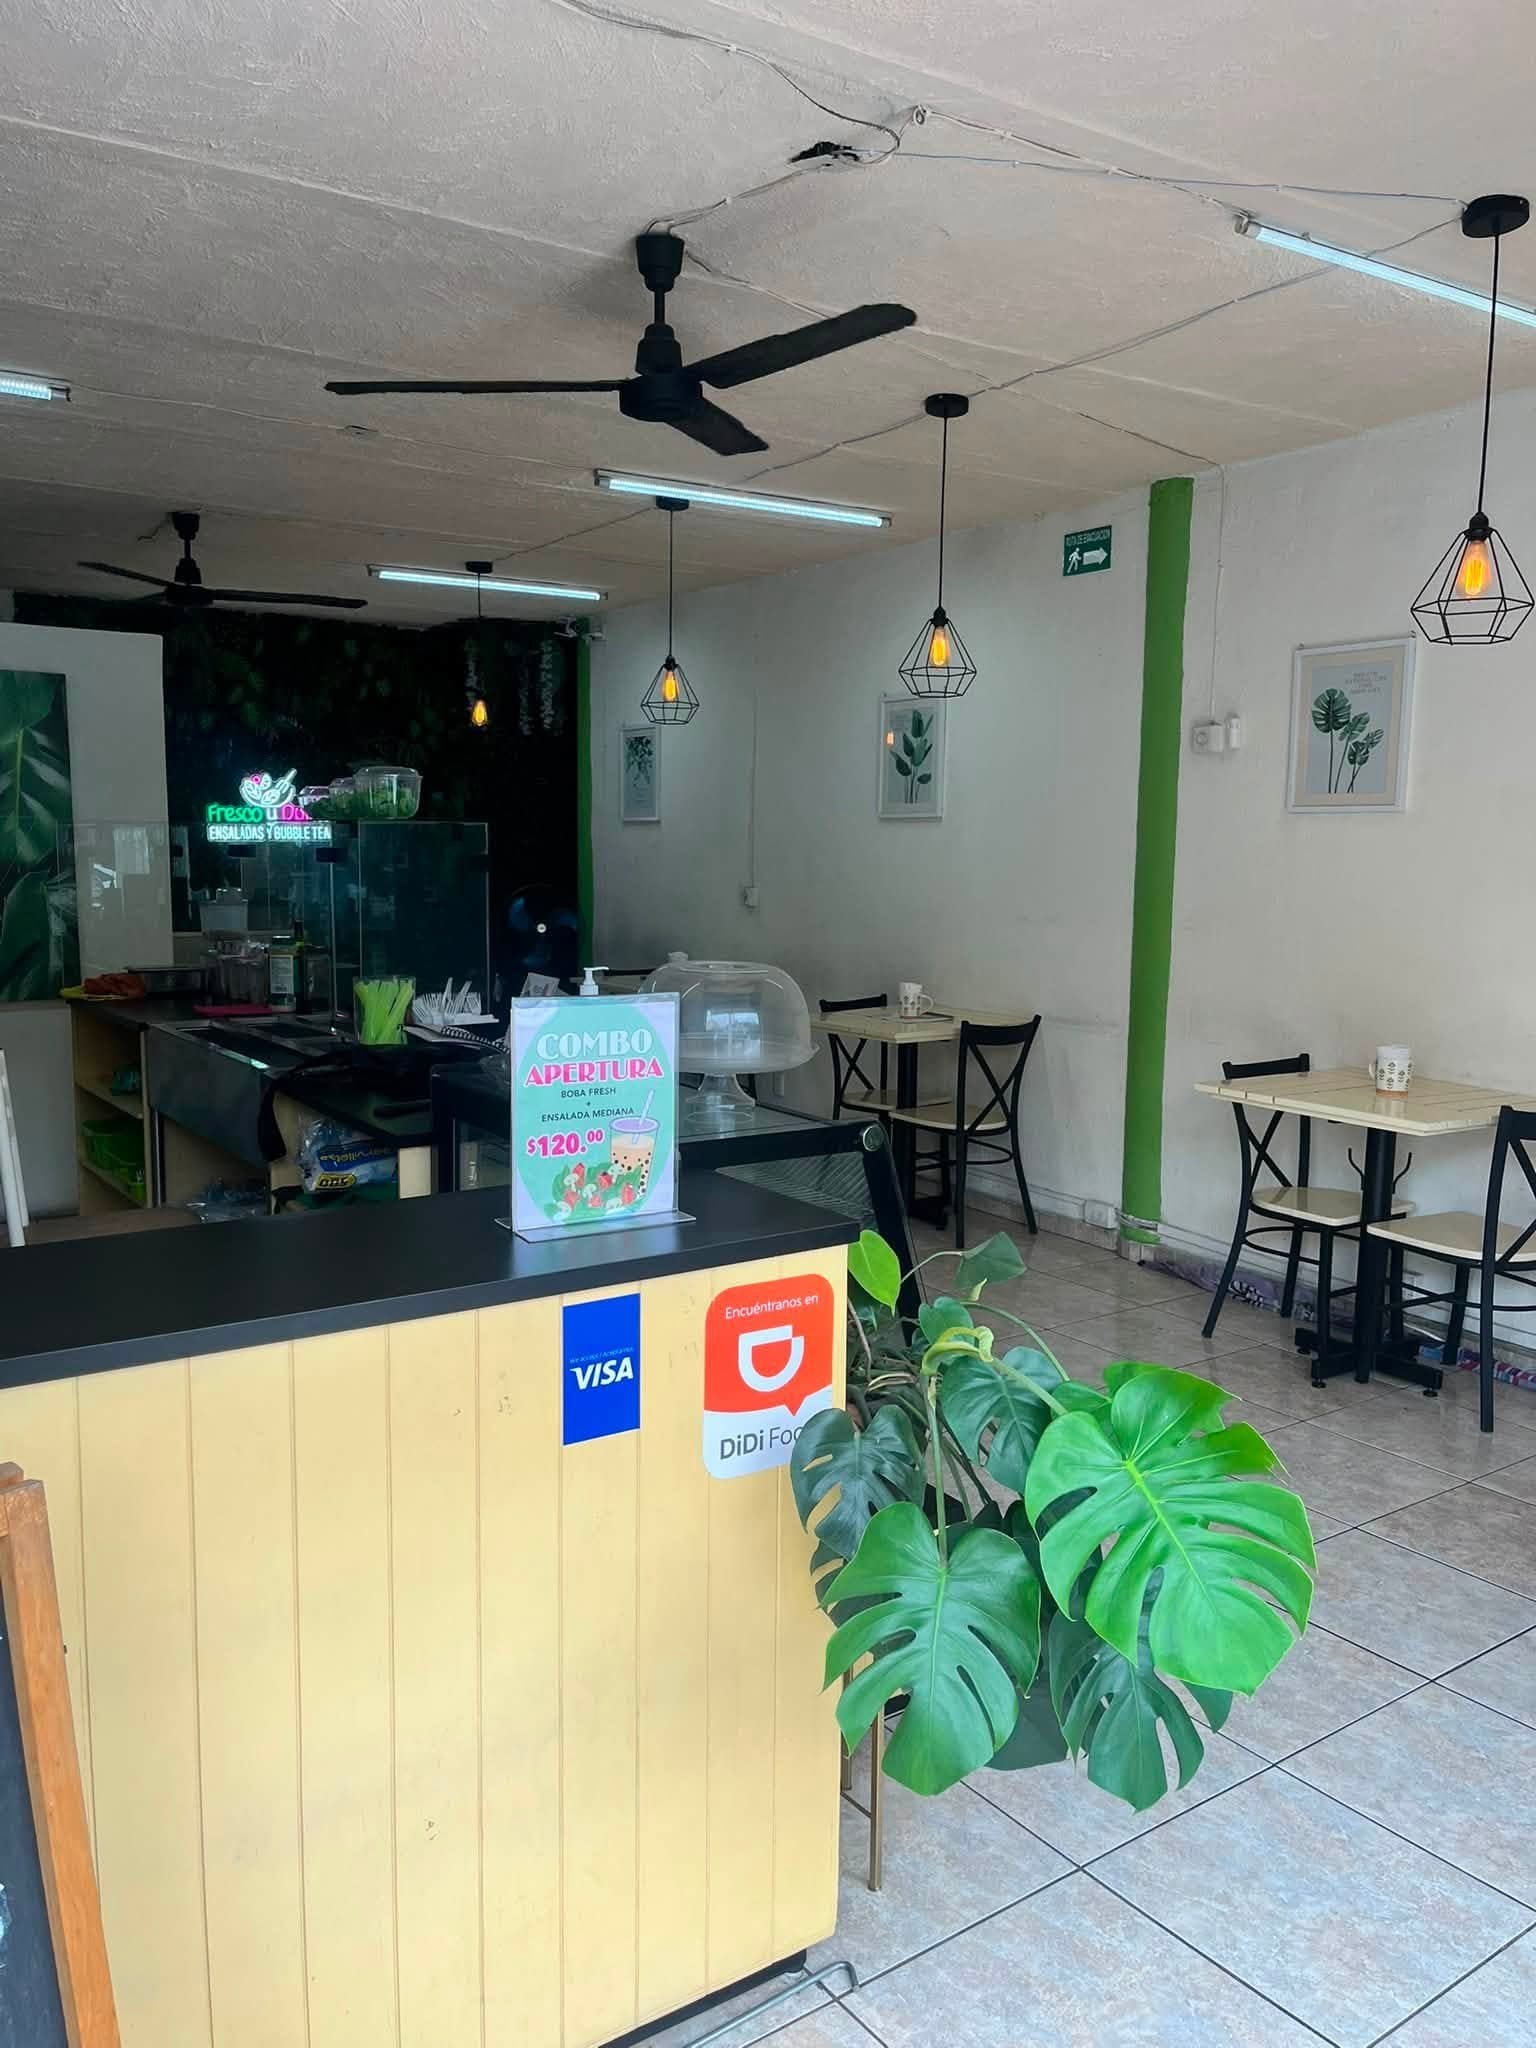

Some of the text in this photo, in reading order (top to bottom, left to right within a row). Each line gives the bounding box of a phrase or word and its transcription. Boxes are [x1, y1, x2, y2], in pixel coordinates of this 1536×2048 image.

[208, 804, 263, 822] Fresco
[209, 822, 331, 840] ENSALADAS Y BUBBLE TEA
[537, 1028, 652, 1060] COMBO
[524, 1056, 664, 1087] APERTURA
[561, 1087, 616, 1098] BOBA FRESH
[542, 1107, 634, 1122] ENSALADA MEDIANA
[725, 1293, 819, 1320] Encuéntranos en
[569, 1357, 634, 1390] VISA
[720, 1426, 802, 1460] DiDi Foo
